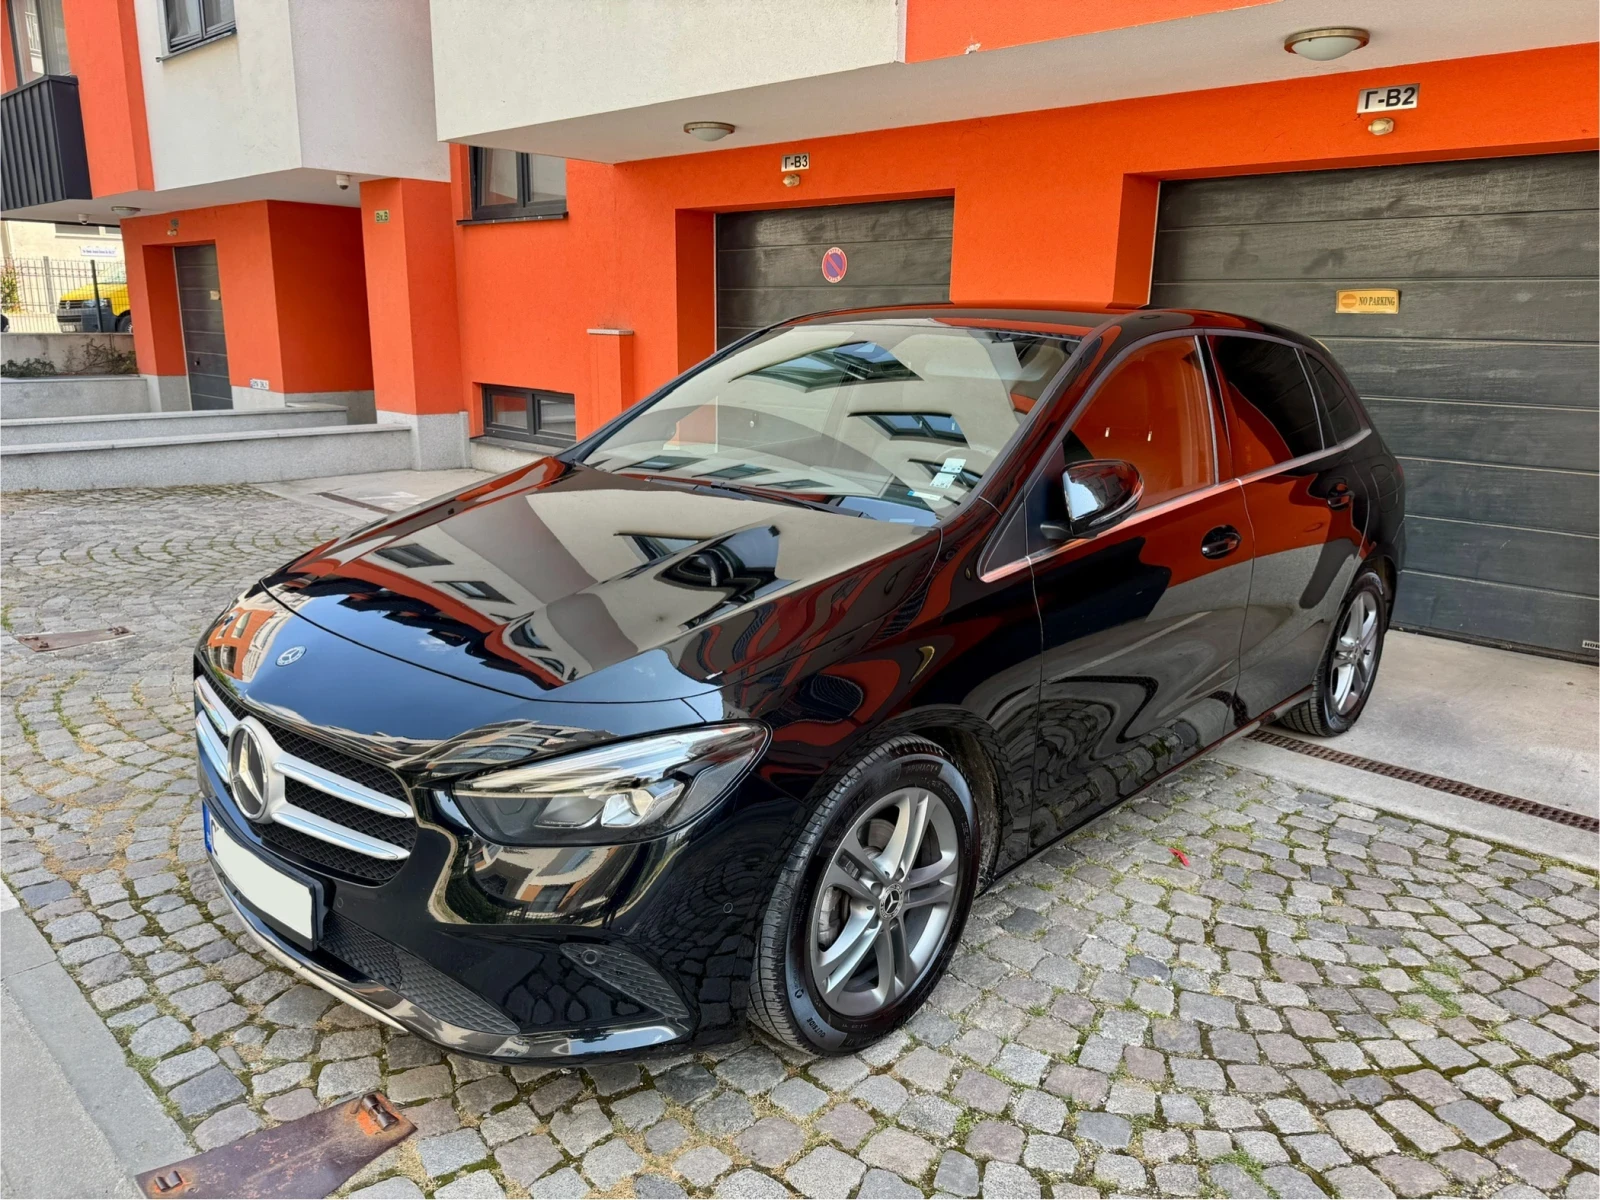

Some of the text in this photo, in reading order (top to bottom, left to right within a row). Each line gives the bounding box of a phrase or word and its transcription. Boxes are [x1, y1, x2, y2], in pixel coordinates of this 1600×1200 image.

[1364, 86, 1416, 110] Г-В2
[784, 155, 808, 169] Г-В3
[1358, 296, 1396, 307] NO PARKING
[806, 1017, 826, 1038] OUTSIDE
